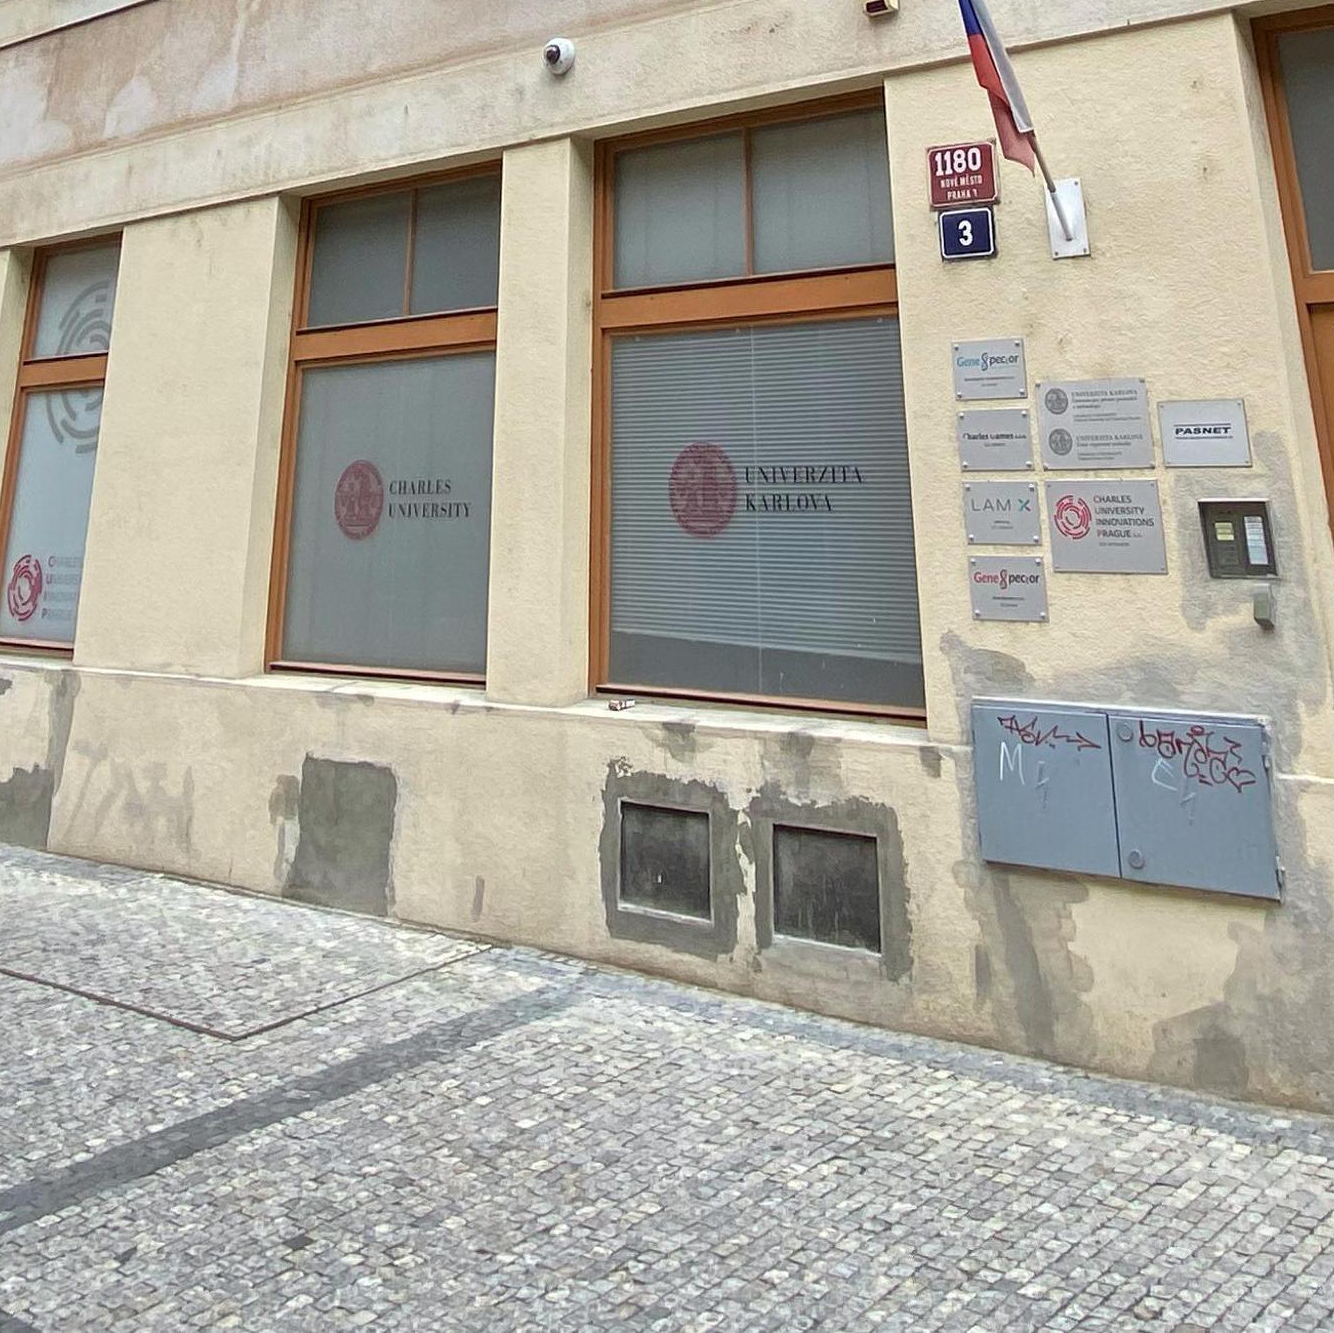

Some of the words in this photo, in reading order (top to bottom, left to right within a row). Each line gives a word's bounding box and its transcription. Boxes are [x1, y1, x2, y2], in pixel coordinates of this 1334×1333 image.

[935, 147, 981, 176] 1180
[947, 190, 971, 200] PRAHA
[958, 220, 973, 246] 3
[1175, 427, 1231, 435] PASNET
[745, 466, 863, 484] UNIVERZITA
[389, 479, 452, 495] CHARLES
[745, 493, 833, 512] KARLOVA
[971, 498, 1011, 512] LAM
[1093, 495, 1132, 503] CHARLES
[388, 502, 471, 519] UNIVERSITY
[1094, 507, 1145, 515] UNIVERSITY
[1095, 518, 1155, 527] INNOVATIONS
[1096, 529, 1132, 538] PRAGUE
